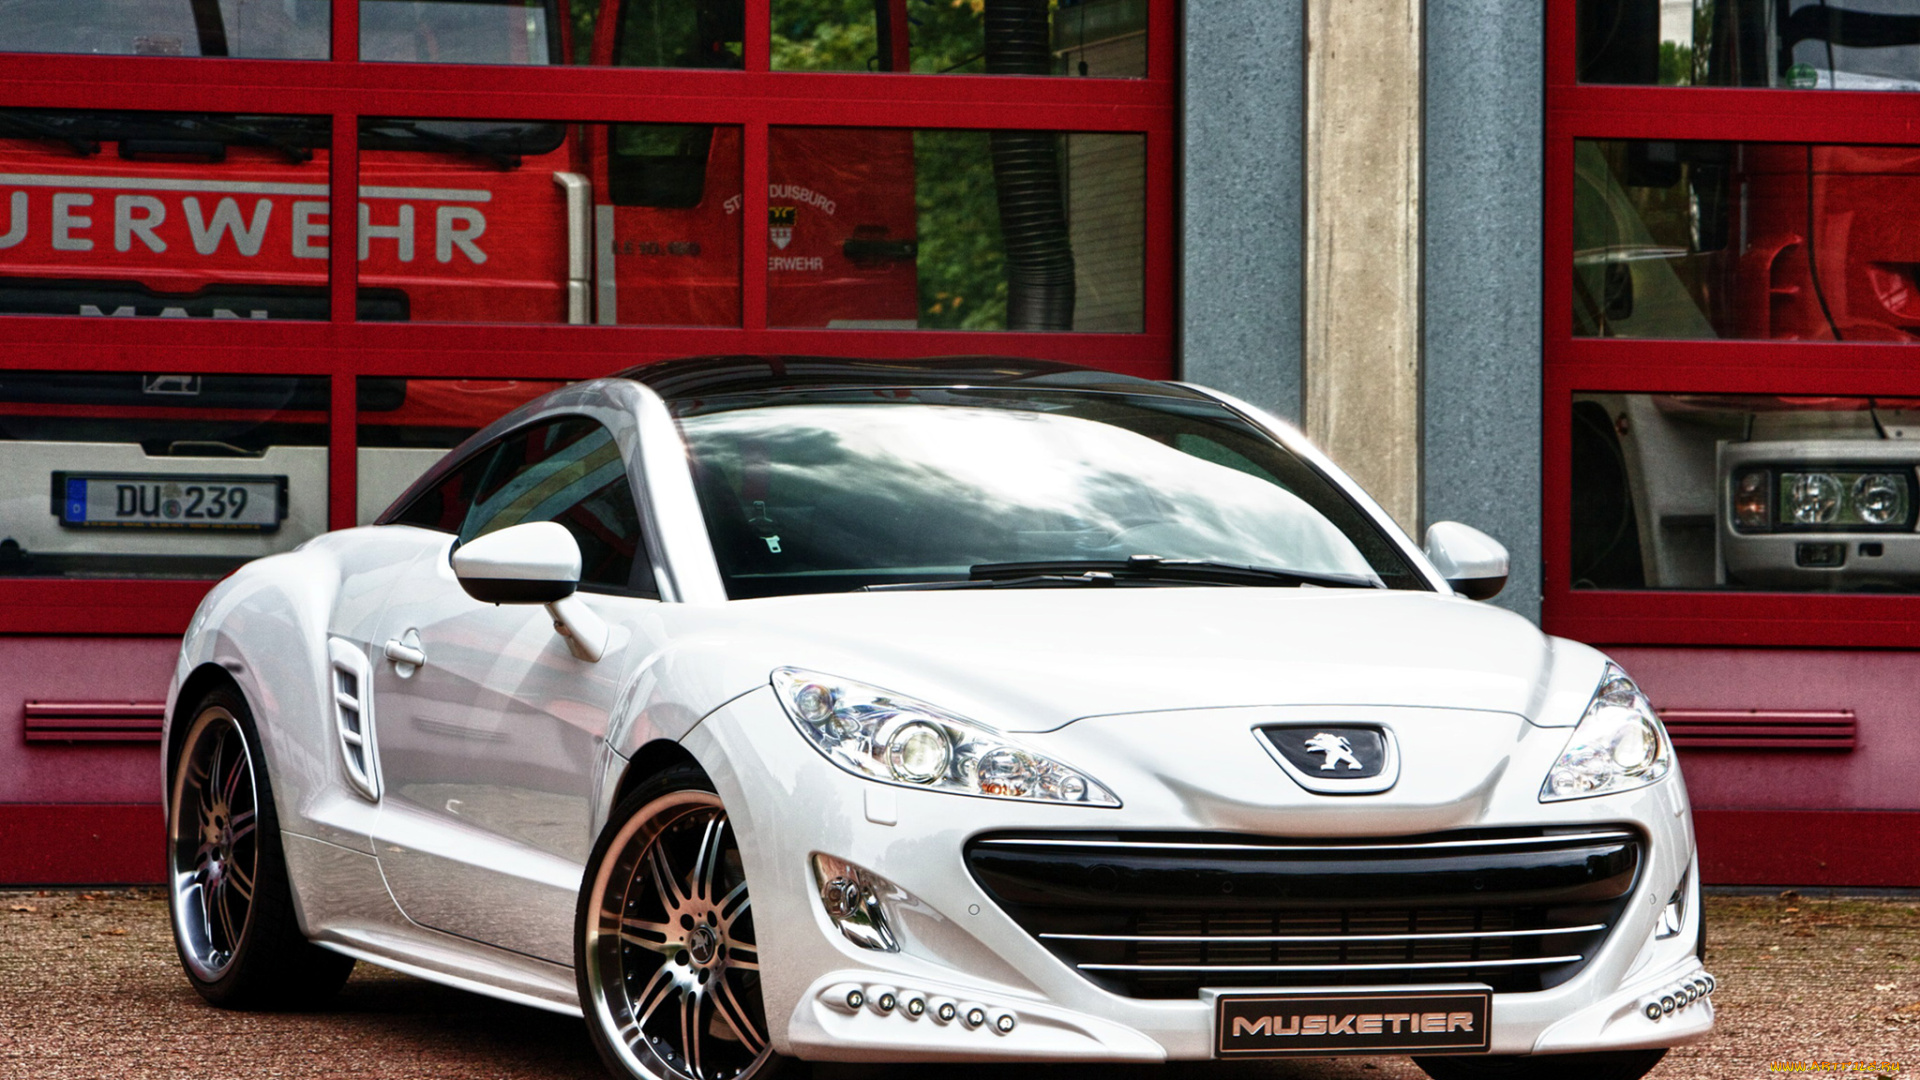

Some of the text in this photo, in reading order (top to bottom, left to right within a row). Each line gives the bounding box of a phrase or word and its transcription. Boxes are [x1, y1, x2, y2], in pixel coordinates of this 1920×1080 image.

[768, 183, 837, 216] DUISBURG
[116, 484, 248, 519] DU 239
[1232, 1011, 1475, 1037] MUSKETIER
